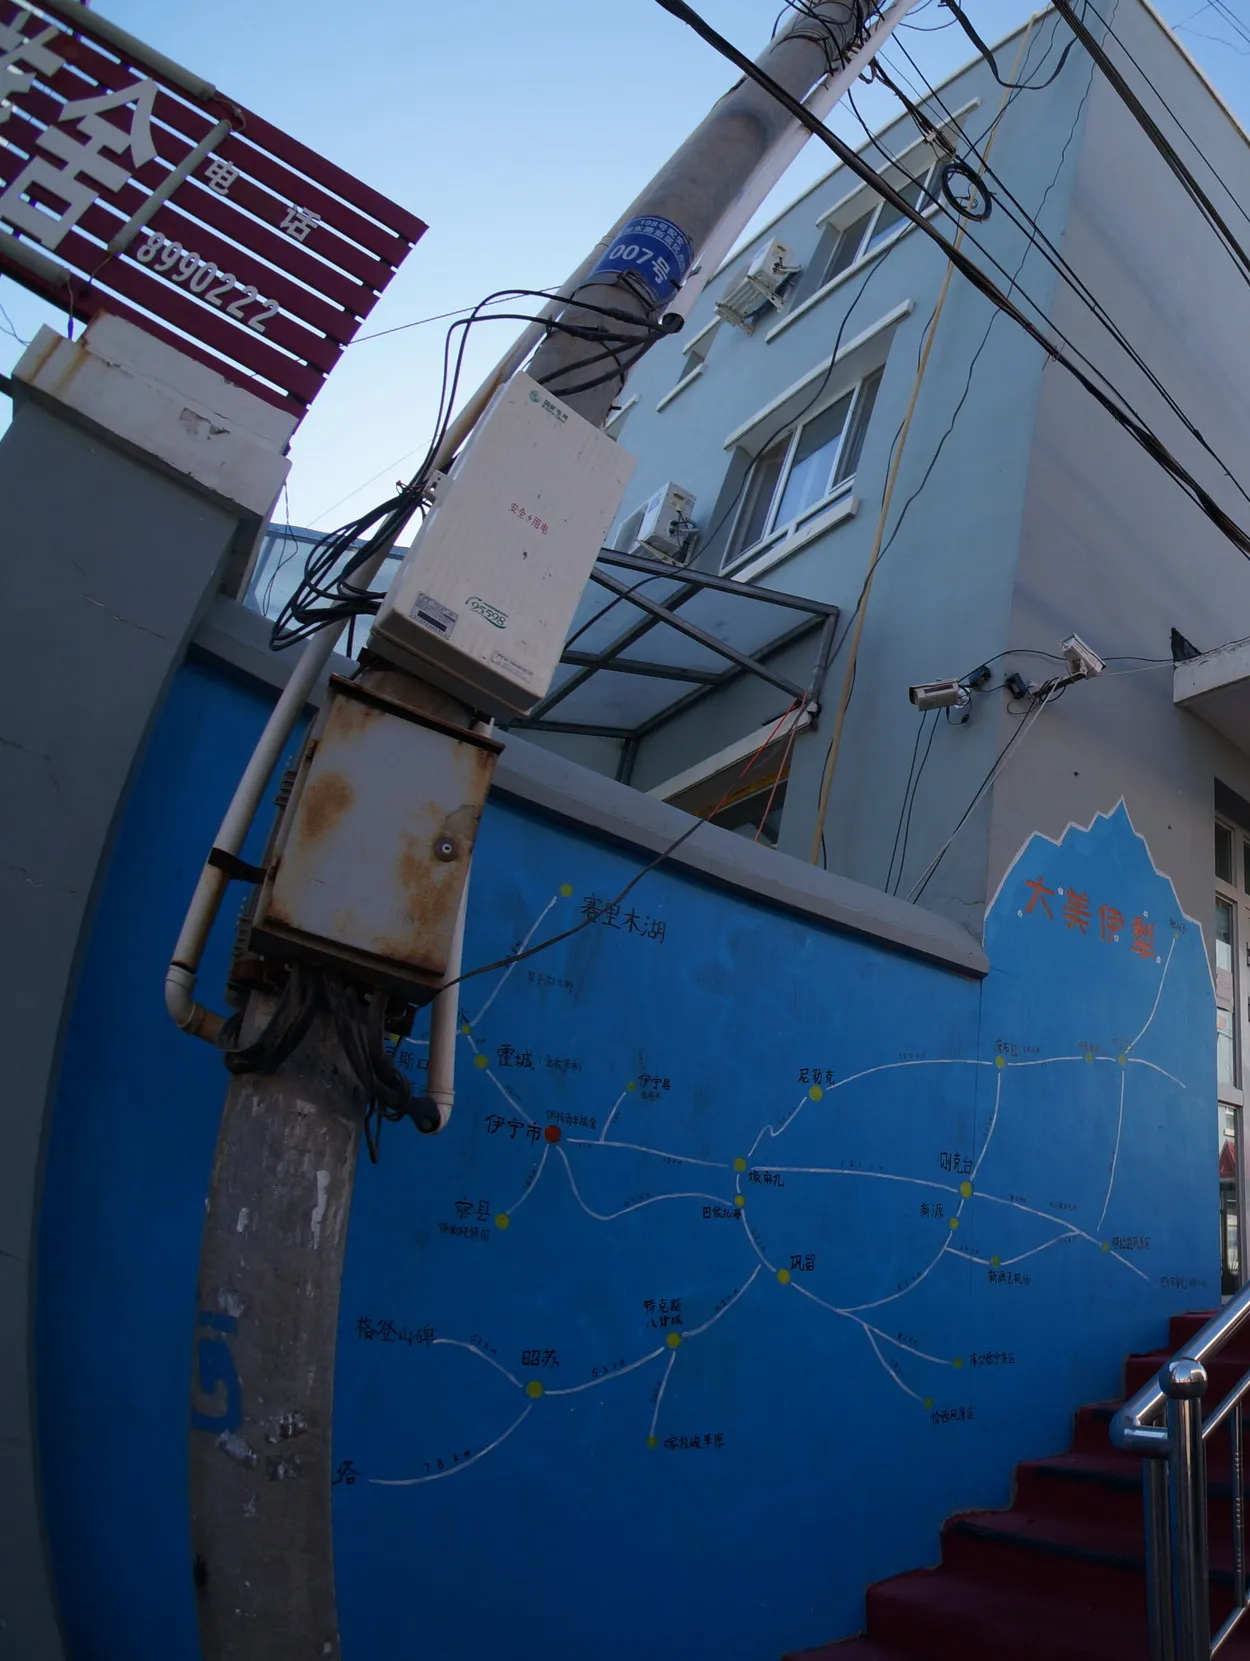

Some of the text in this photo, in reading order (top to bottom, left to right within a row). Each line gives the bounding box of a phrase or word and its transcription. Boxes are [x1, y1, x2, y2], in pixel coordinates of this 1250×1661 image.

[205, 160, 321, 242] 电话
[608, 244, 671, 284] 007号
[136, 231, 280, 333] 8990222
[508, 502, 549, 536] 安全 用电
[471, 601, 507, 626] 95598
[1025, 875, 1156, 961] 大美伊犁
[484, 1113, 542, 1147] 伊宁市
[454, 1197, 492, 1222] 察县
[920, 1202, 944, 1219] 新源
[356, 1316, 436, 1349] 格登山碑
[522, 1349, 560, 1369] 昭苏
